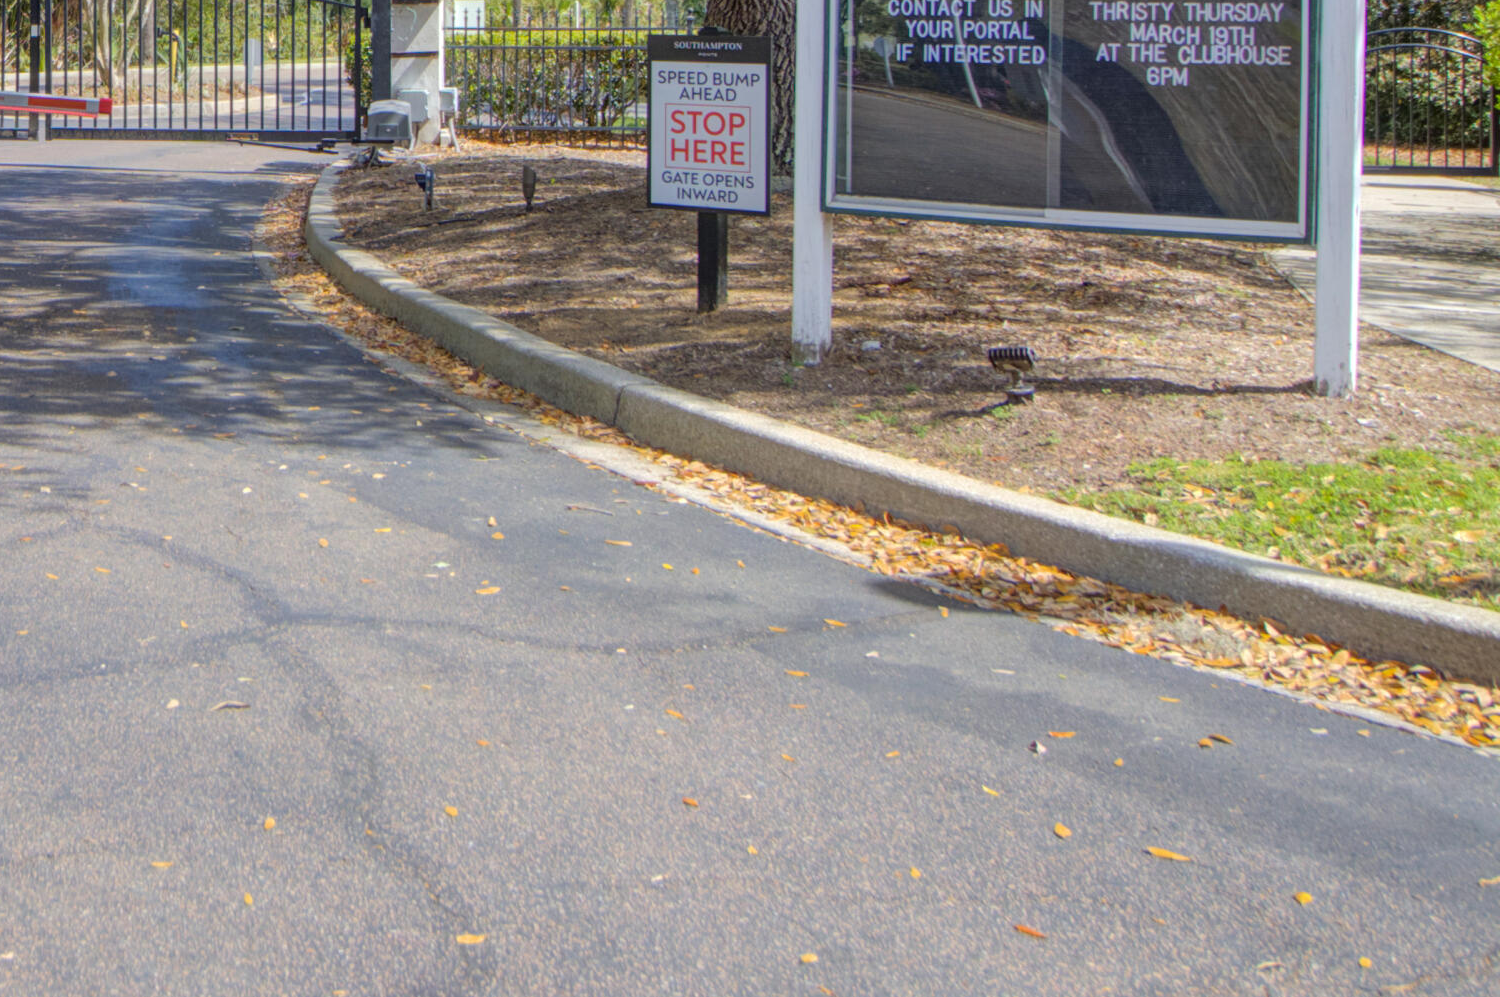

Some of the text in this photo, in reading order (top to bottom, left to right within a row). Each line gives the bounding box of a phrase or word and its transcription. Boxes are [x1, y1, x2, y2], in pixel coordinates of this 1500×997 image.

[1024, 0, 1044, 18] IN
[1089, 1, 1285, 23] THRISTY THURSDAY
[905, 20, 1035, 40] YOUR PORTAL
[1130, 23, 1256, 46] MARCH 19TH
[673, 41, 743, 51] SOUTHAMPTON
[896, 43, 1046, 65] IF INTERESTED
[1095, 43, 1292, 66] AT THE CLUBHOUSE
[658, 70, 760, 87] SPEED BUMP
[1146, 67, 1189, 86] 6PM
[679, 87, 737, 101] AHEAD
[670, 110, 746, 136] STOP
[670, 138, 746, 166] HERE
[661, 171, 755, 189] GATE OPENS
[677, 187, 739, 203] INWARD
